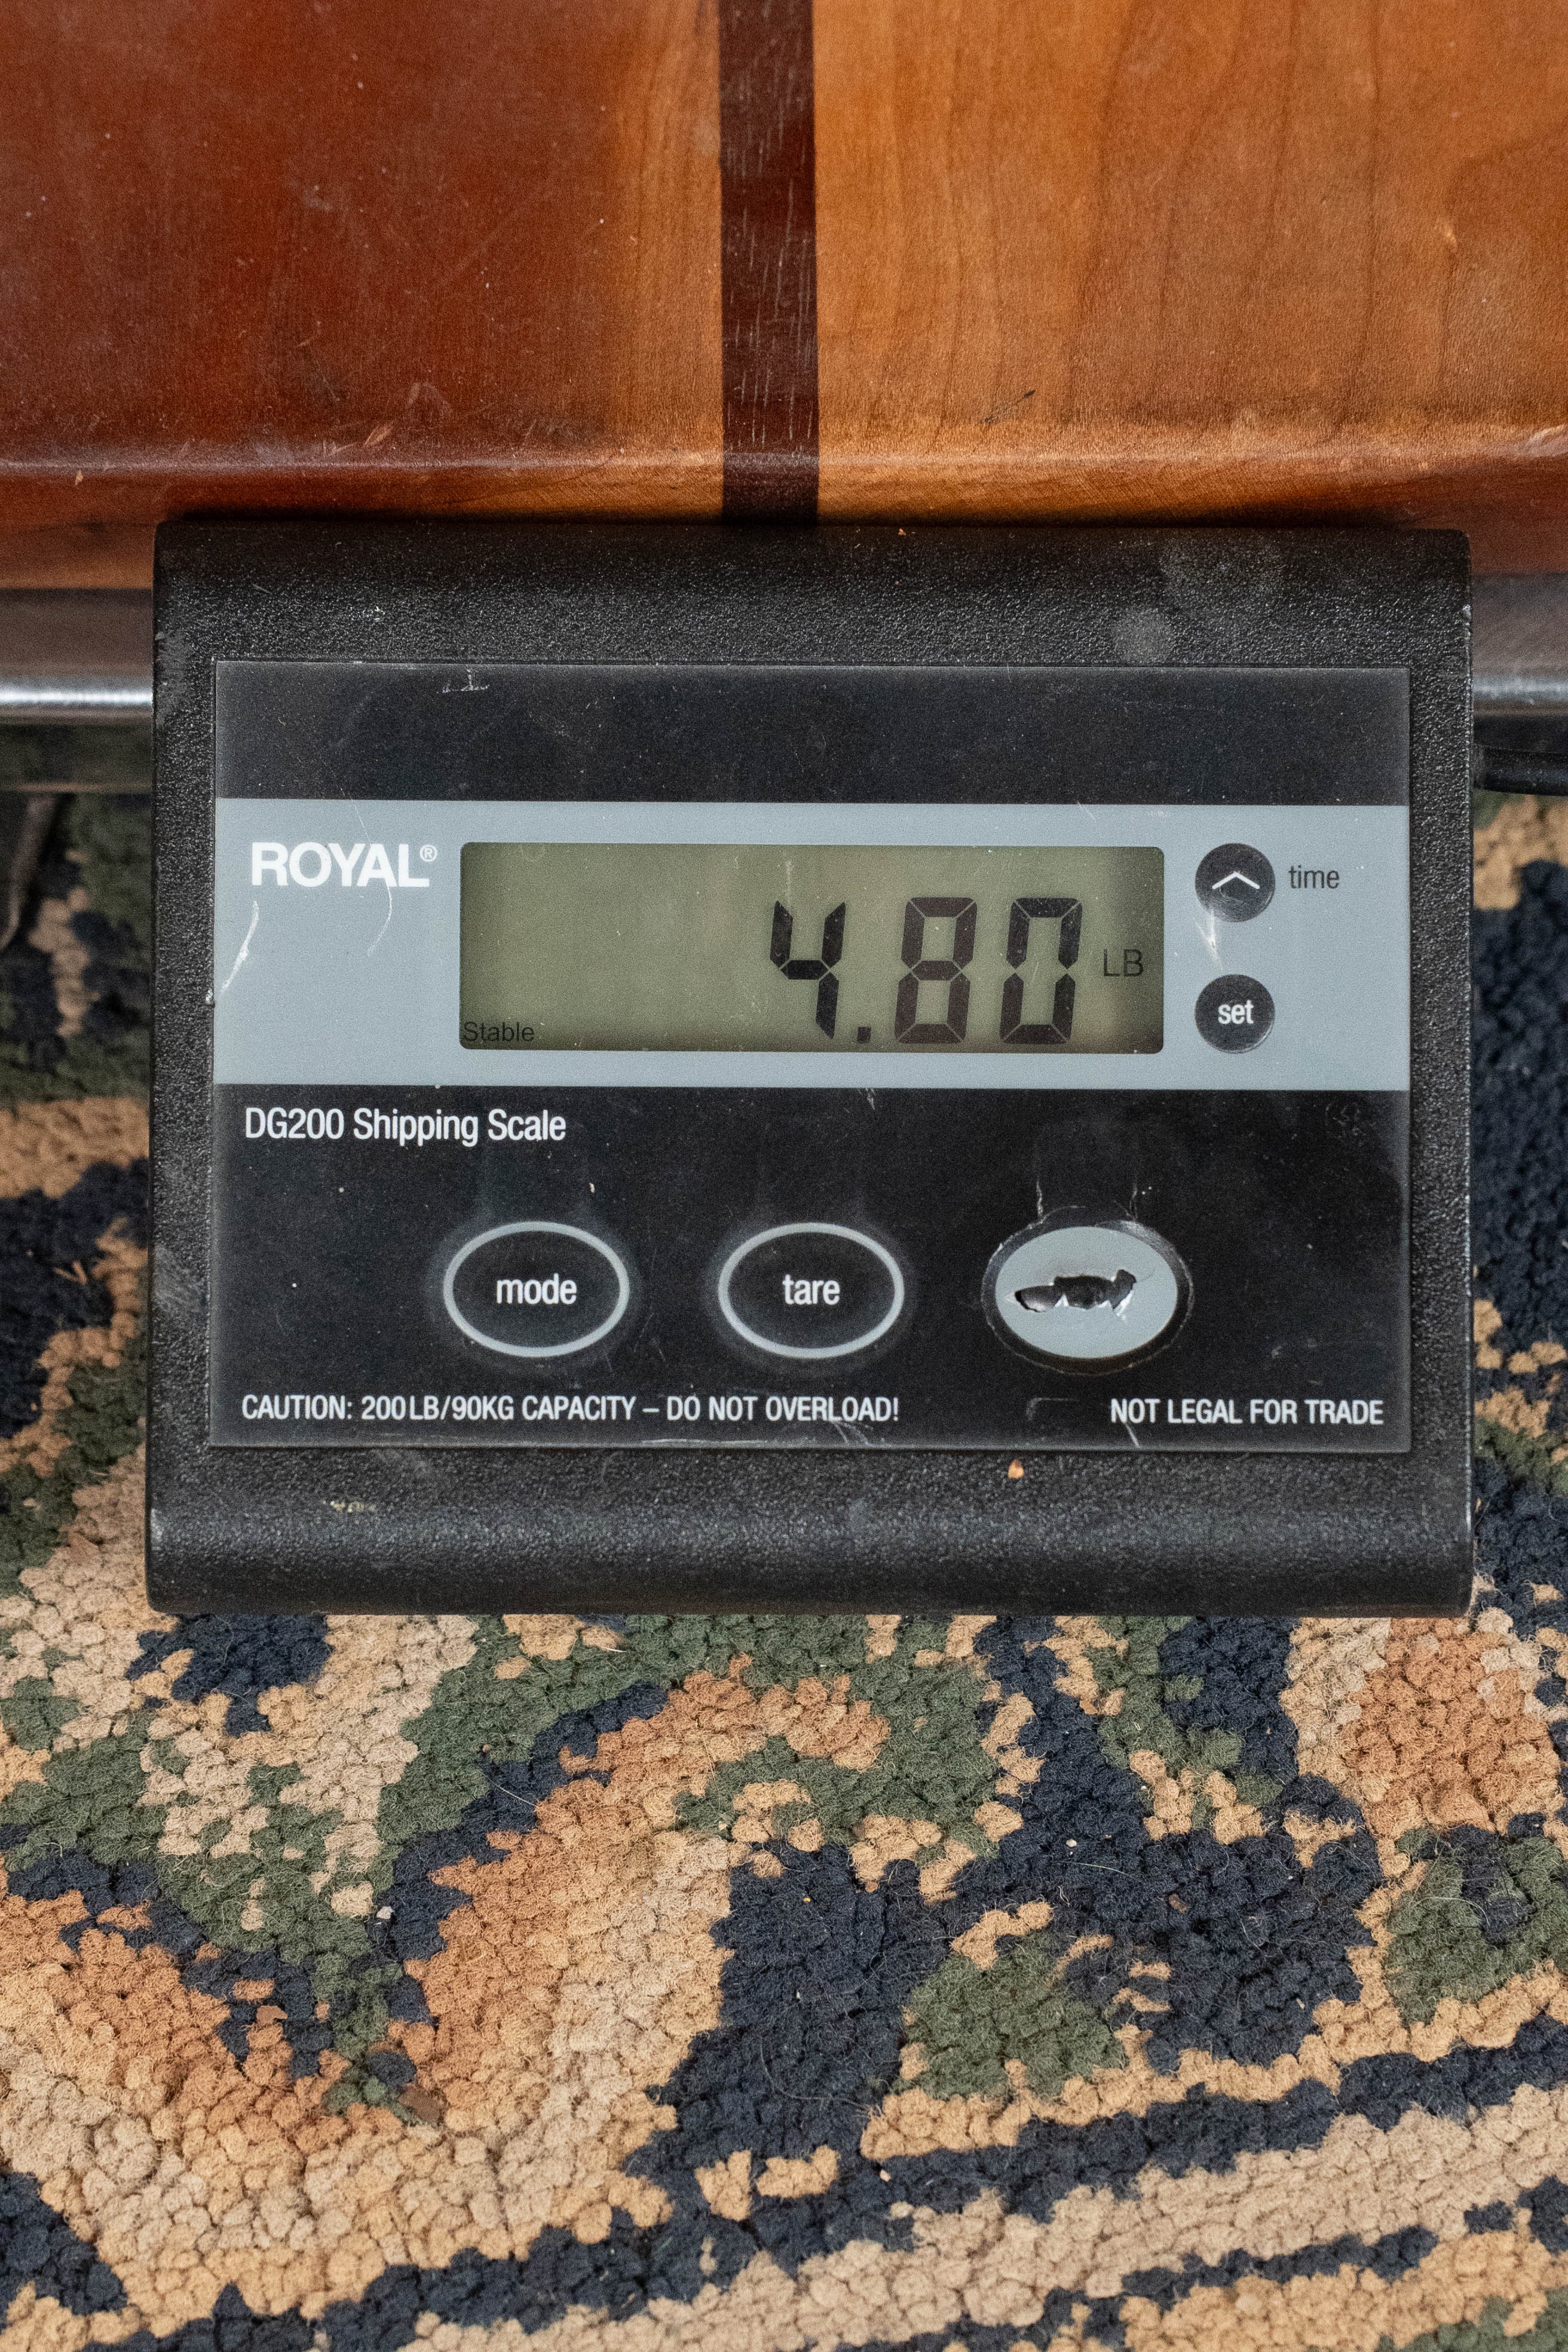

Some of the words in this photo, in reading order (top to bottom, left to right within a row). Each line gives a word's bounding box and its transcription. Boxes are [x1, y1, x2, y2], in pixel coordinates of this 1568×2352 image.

[1289, 866, 1340, 889] time
[770, 897, 1083, 1044] 4.80
[1103, 949, 1144, 977] LB
[1218, 1001, 1254, 1025] set
[463, 1021, 535, 1043] Stable
[245, 1108, 344, 1140] DG200
[354, 1109, 477, 1147] Shipping
[488, 1110, 566, 1141] Scale
[496, 1273, 577, 1304] mode
[783, 1274, 840, 1305] tare
[241, 1394, 353, 1420] CAUTION:
[522, 1395, 636, 1421] CAPACITY
[667, 1396, 701, 1422] DO
[709, 1396, 757, 1422] NOT
[765, 1397, 899, 1422] OVERLOAD!
[1110, 1399, 1159, 1423] NOT
[1168, 1399, 1242, 1424] LEGAL
[1250, 1399, 1297, 1425] FOR
[1305, 1400, 1384, 1425] TRADE
